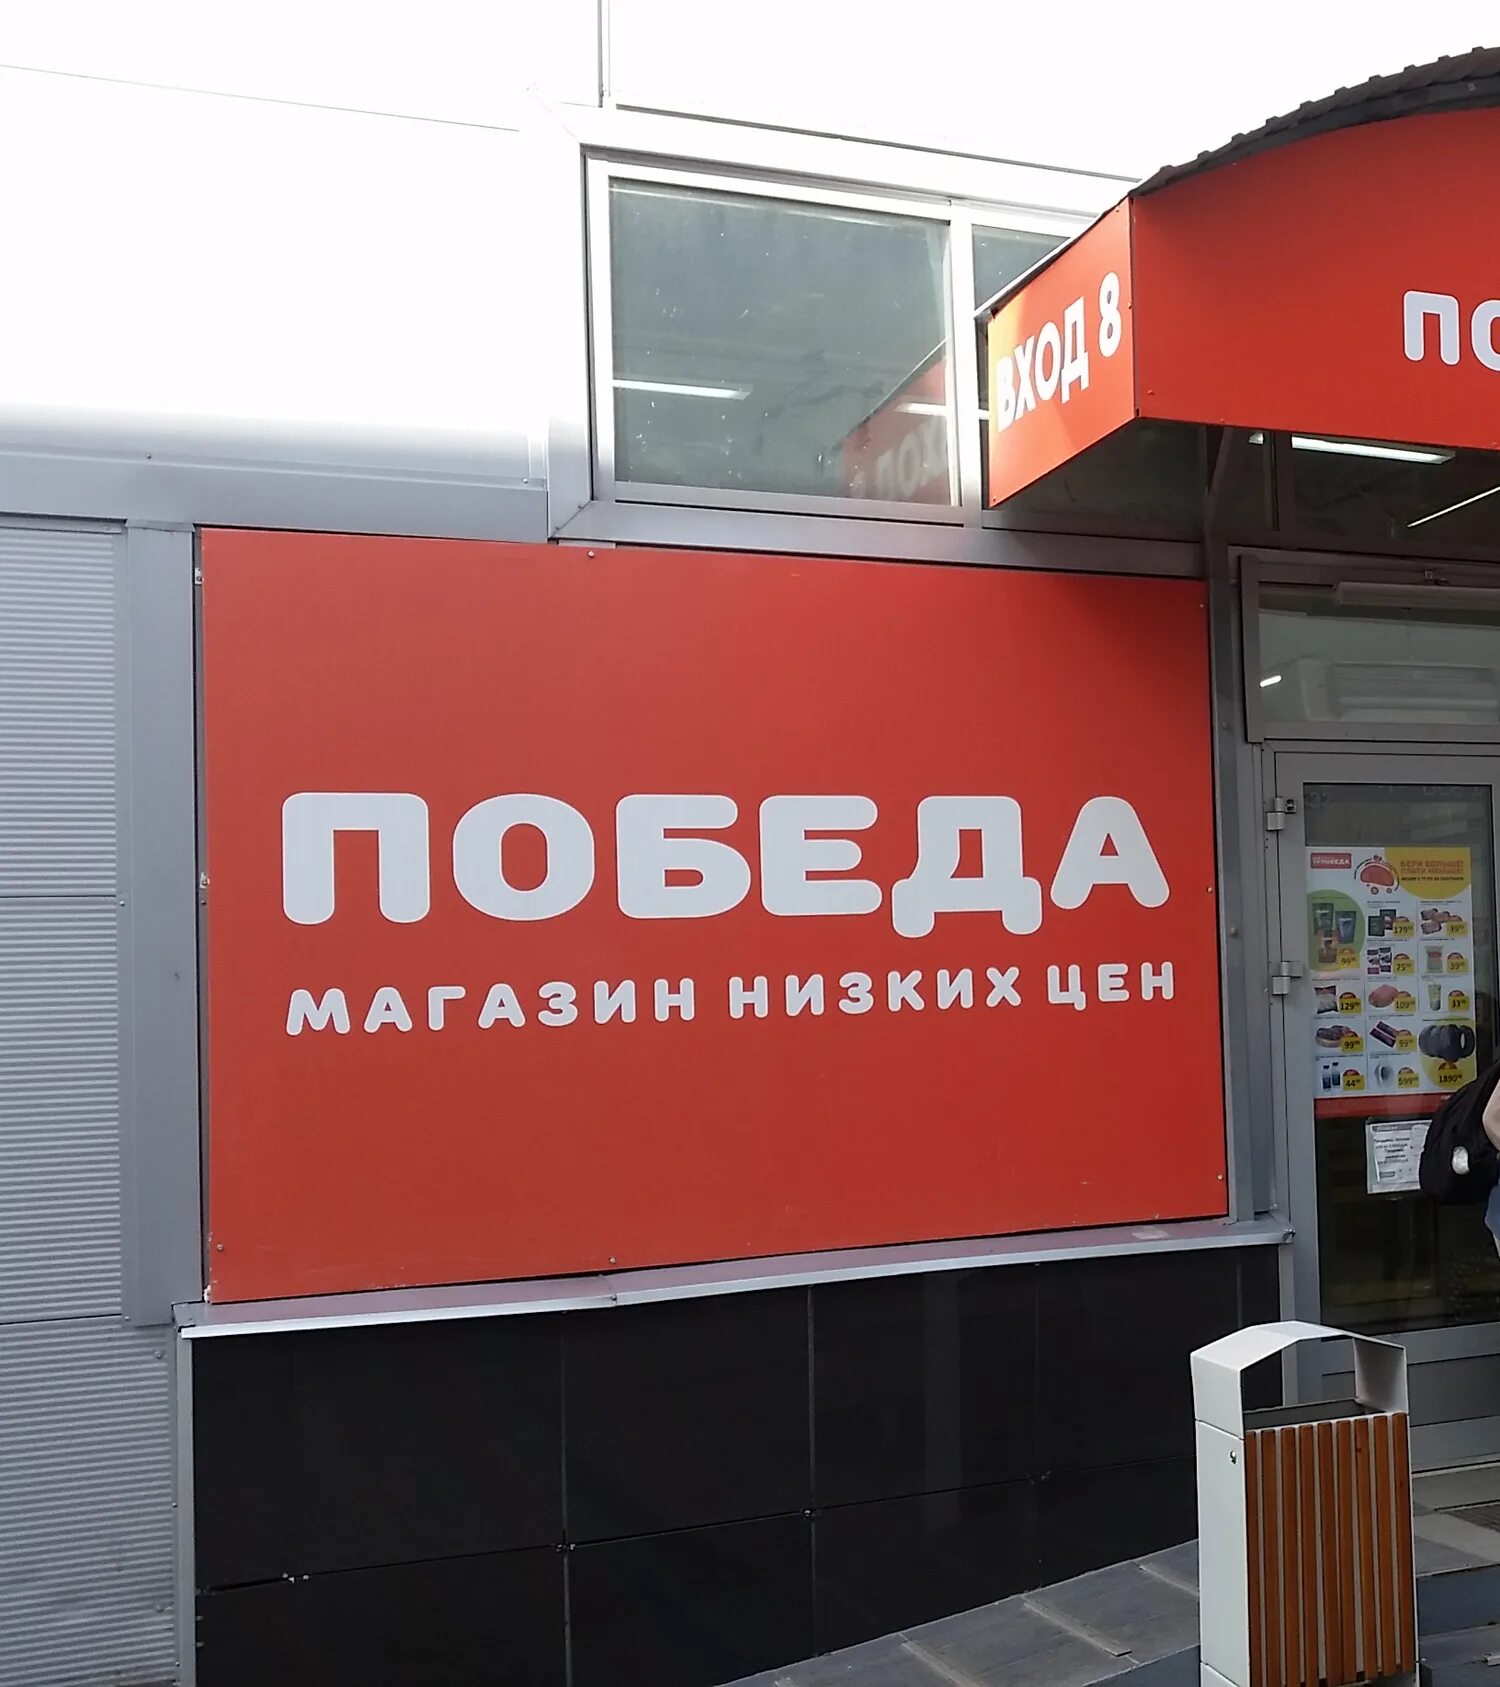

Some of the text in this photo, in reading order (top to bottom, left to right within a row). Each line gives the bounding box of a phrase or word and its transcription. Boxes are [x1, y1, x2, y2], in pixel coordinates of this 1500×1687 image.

[994, 271, 1122, 432] ВХОД 8
[281, 792, 1171, 939] ПОБЕДА
[286, 961, 1174, 1036] МАГАЗИН НИЗКИХ ЦЕН
